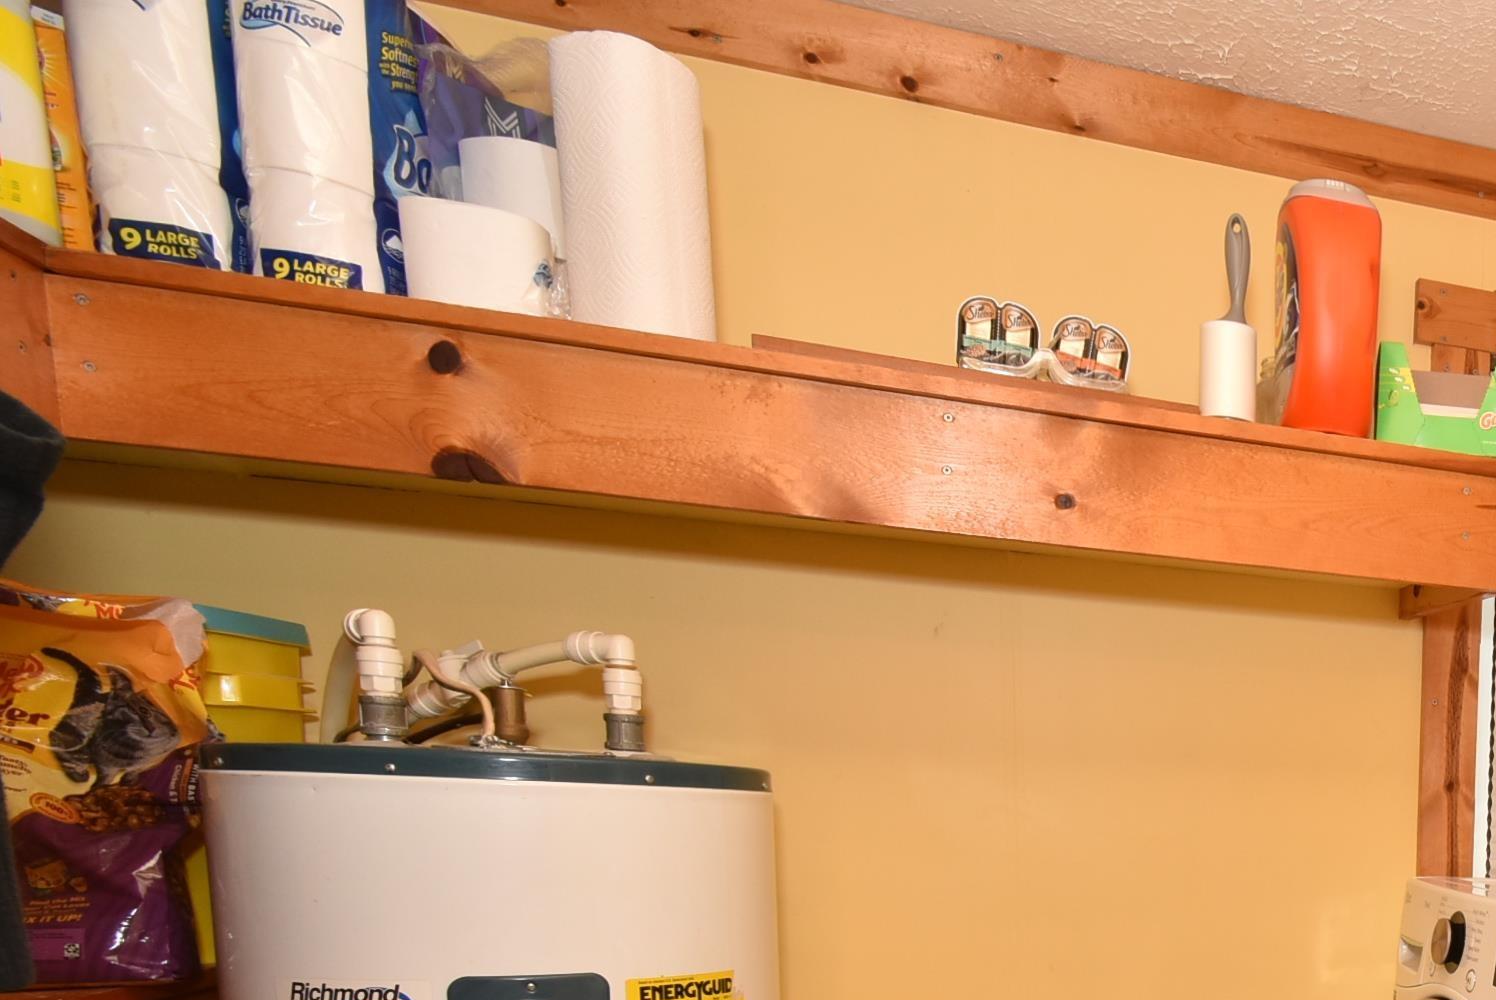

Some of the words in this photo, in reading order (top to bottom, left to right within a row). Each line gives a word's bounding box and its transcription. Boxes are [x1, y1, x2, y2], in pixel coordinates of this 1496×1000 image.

[119, 227, 142, 250] 9
[145, 228, 199, 247] LARGE
[148, 243, 198, 259] ROLLS
[272, 257, 291, 280] 9
[293, 259, 350, 280] LARGE
[295, 273, 347, 289] ROLLS
